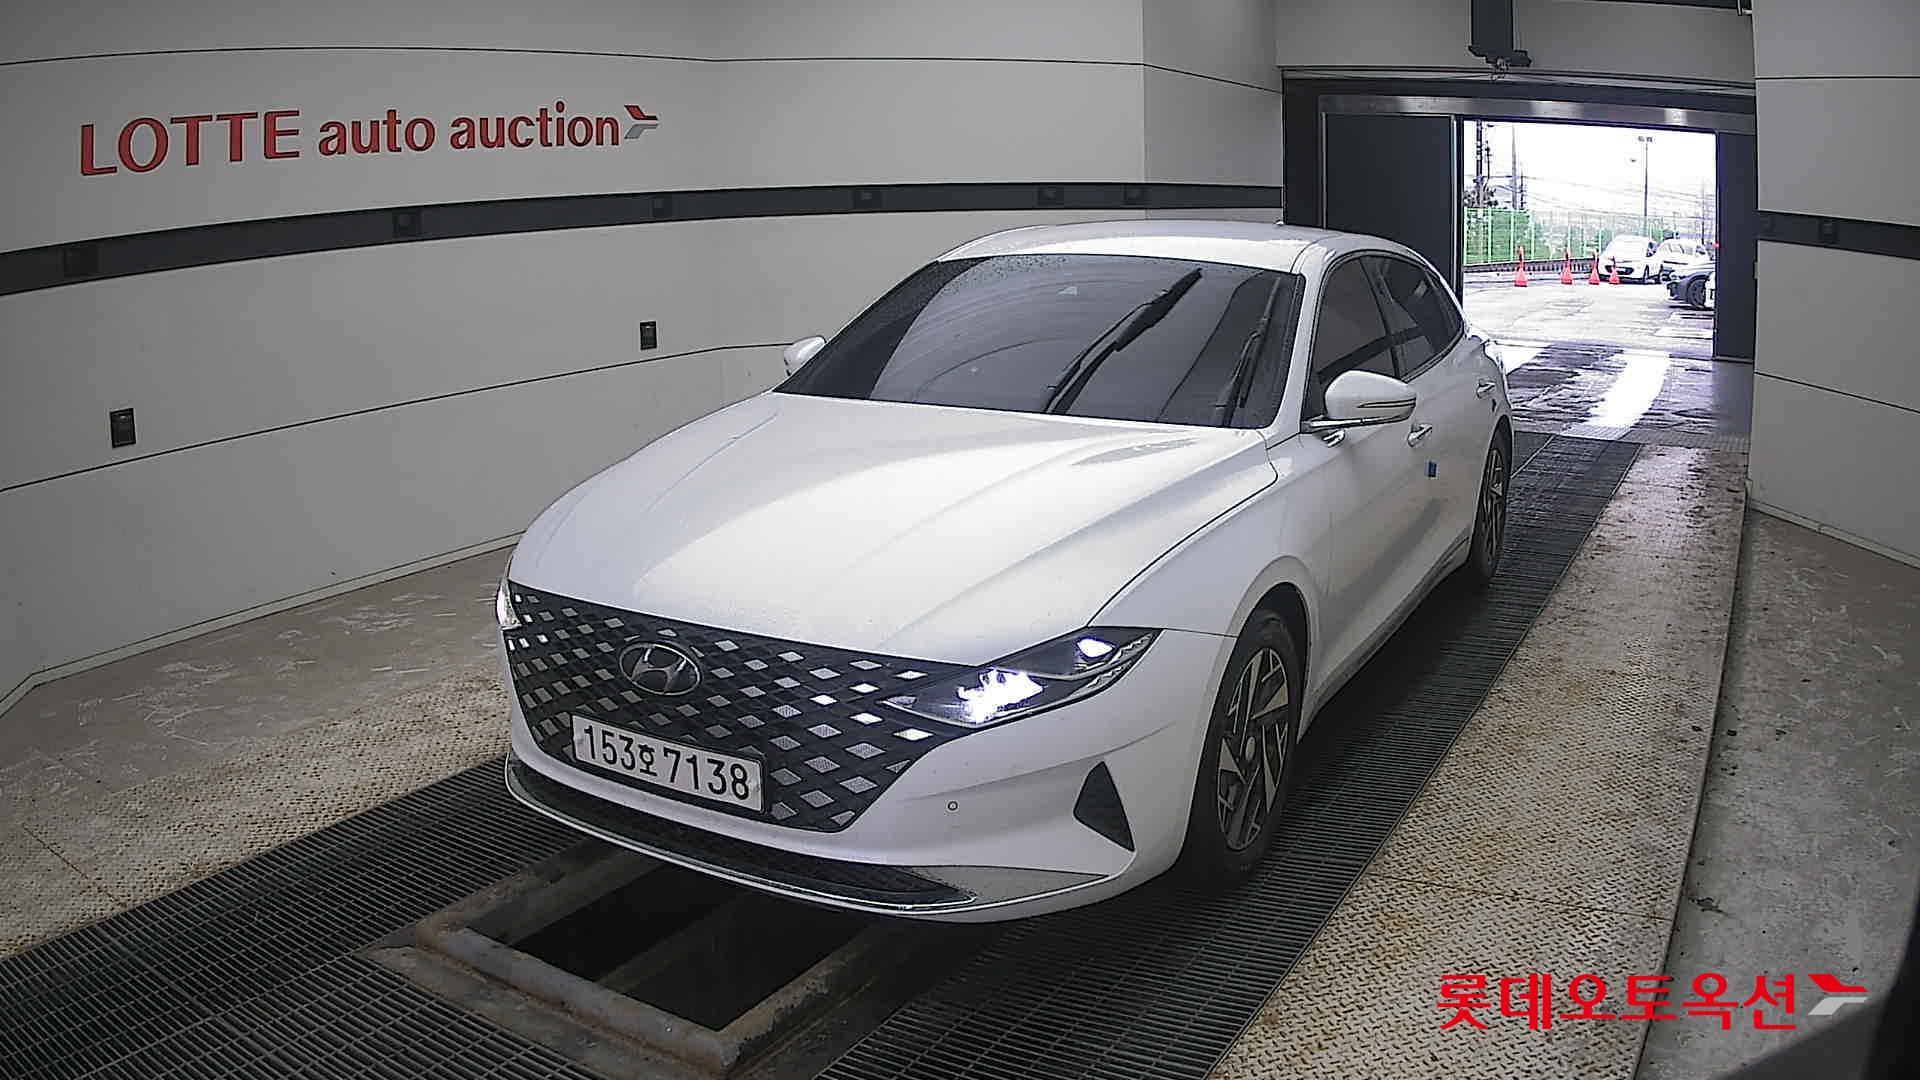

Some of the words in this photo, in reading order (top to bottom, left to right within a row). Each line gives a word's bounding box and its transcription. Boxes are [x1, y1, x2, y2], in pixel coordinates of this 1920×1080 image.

[80, 109, 300, 176] LOTTE
[318, 109, 437, 157] auto
[449, 101, 621, 150] auction
